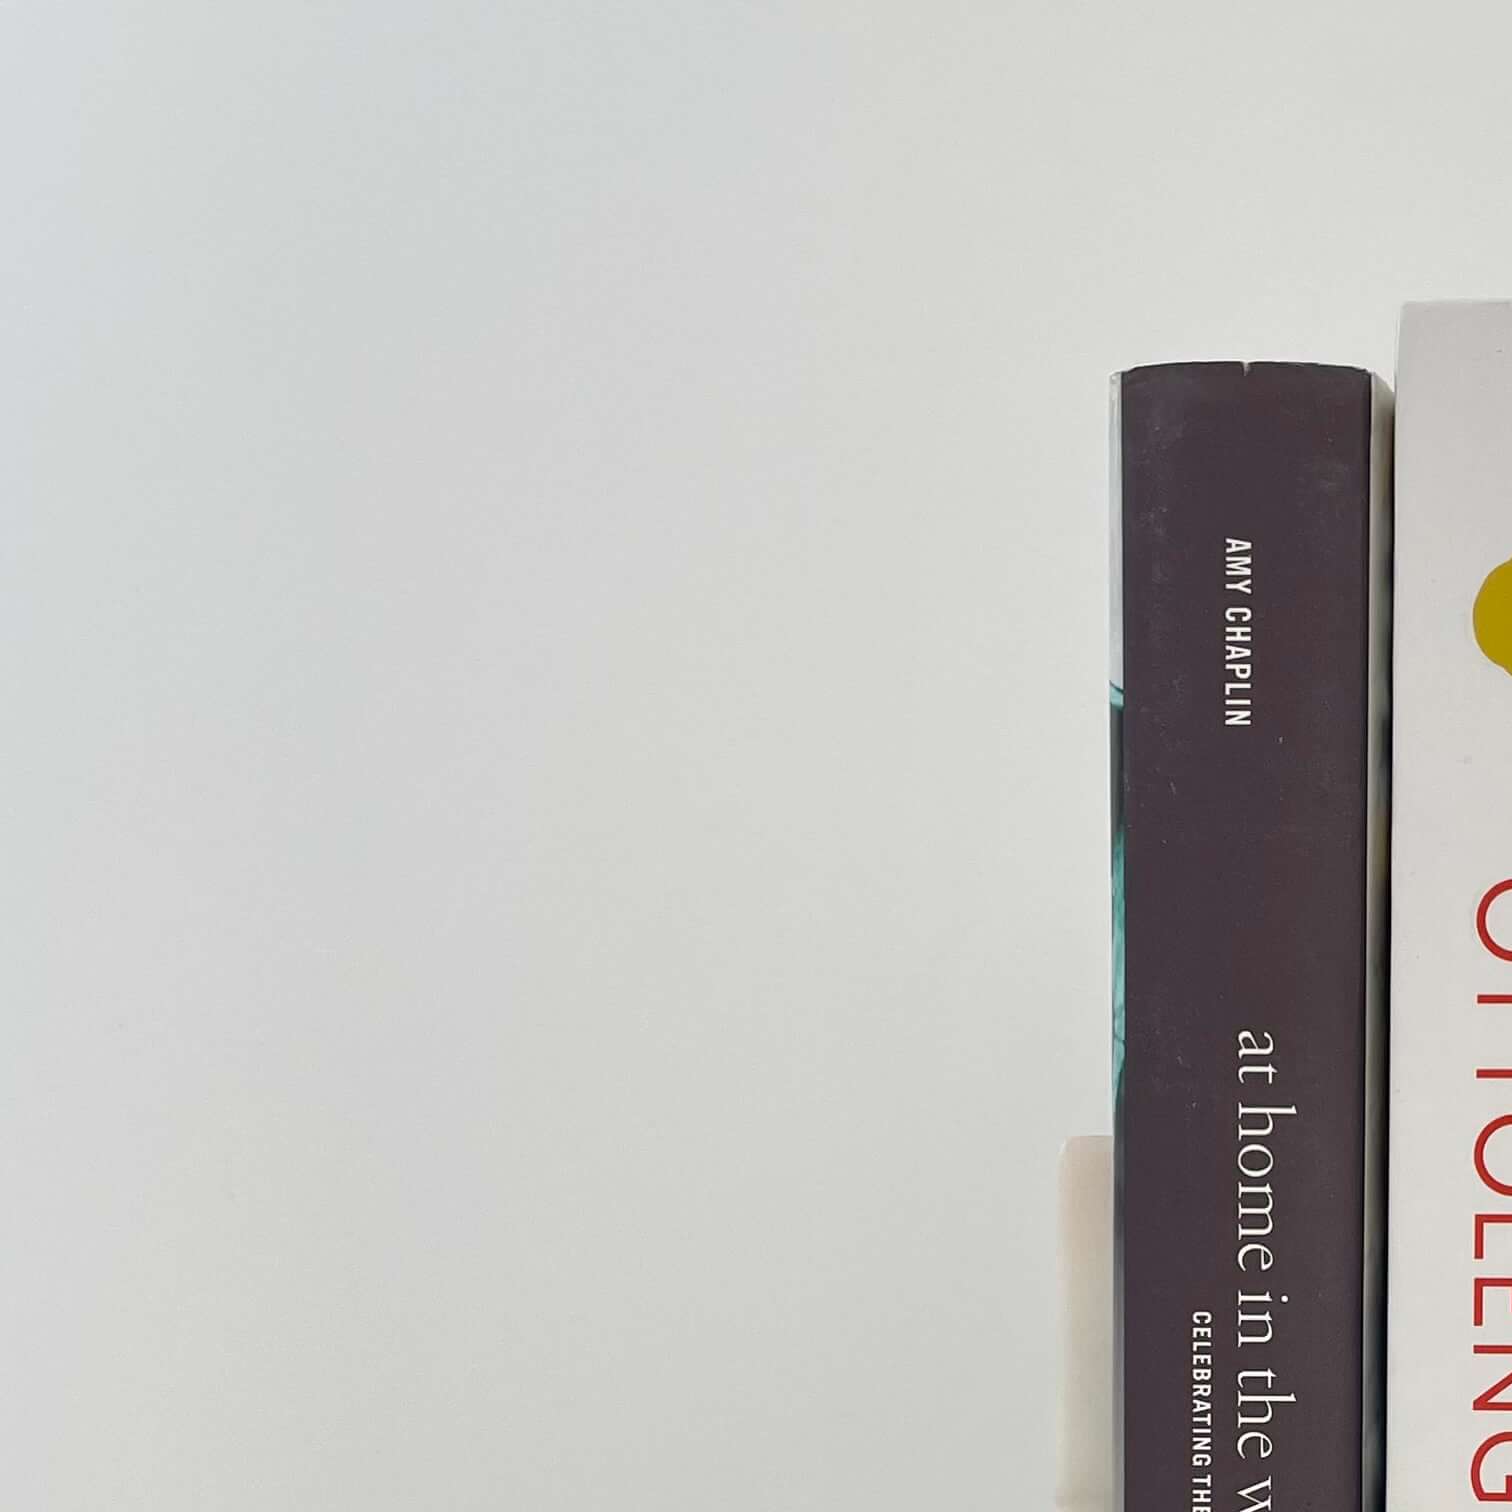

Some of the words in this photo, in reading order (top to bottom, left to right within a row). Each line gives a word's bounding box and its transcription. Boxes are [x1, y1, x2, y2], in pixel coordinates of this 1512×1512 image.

[1224, 536, 1252, 596] AMY
[1224, 606, 1252, 727] CHAPLIN
[1238, 1029, 1278, 1086] at
[1237, 1101, 1297, 1273] home
[1236, 1289, 1289, 1348] in
[1191, 1311, 1212, 1467] CELEBRATING
[1236, 1367, 1297, 1459] the
